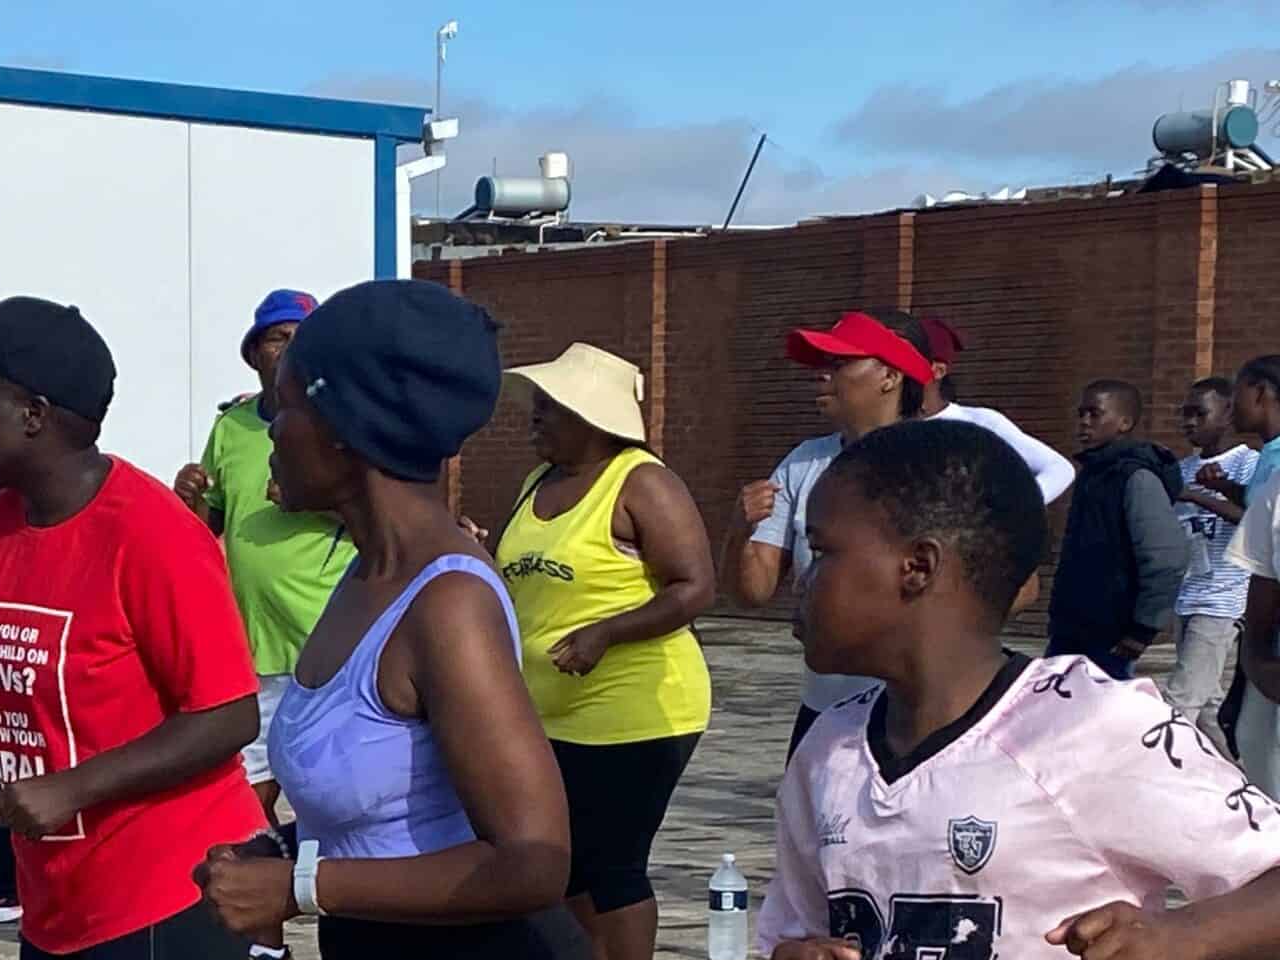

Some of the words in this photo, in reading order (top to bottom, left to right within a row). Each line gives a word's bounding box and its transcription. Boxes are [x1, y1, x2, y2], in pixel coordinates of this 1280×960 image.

[20, 627, 39, 644] OR
[27, 648, 49, 665] ON
[3, 710, 29, 728] YOU
[12, 729, 47, 748] YOUR
